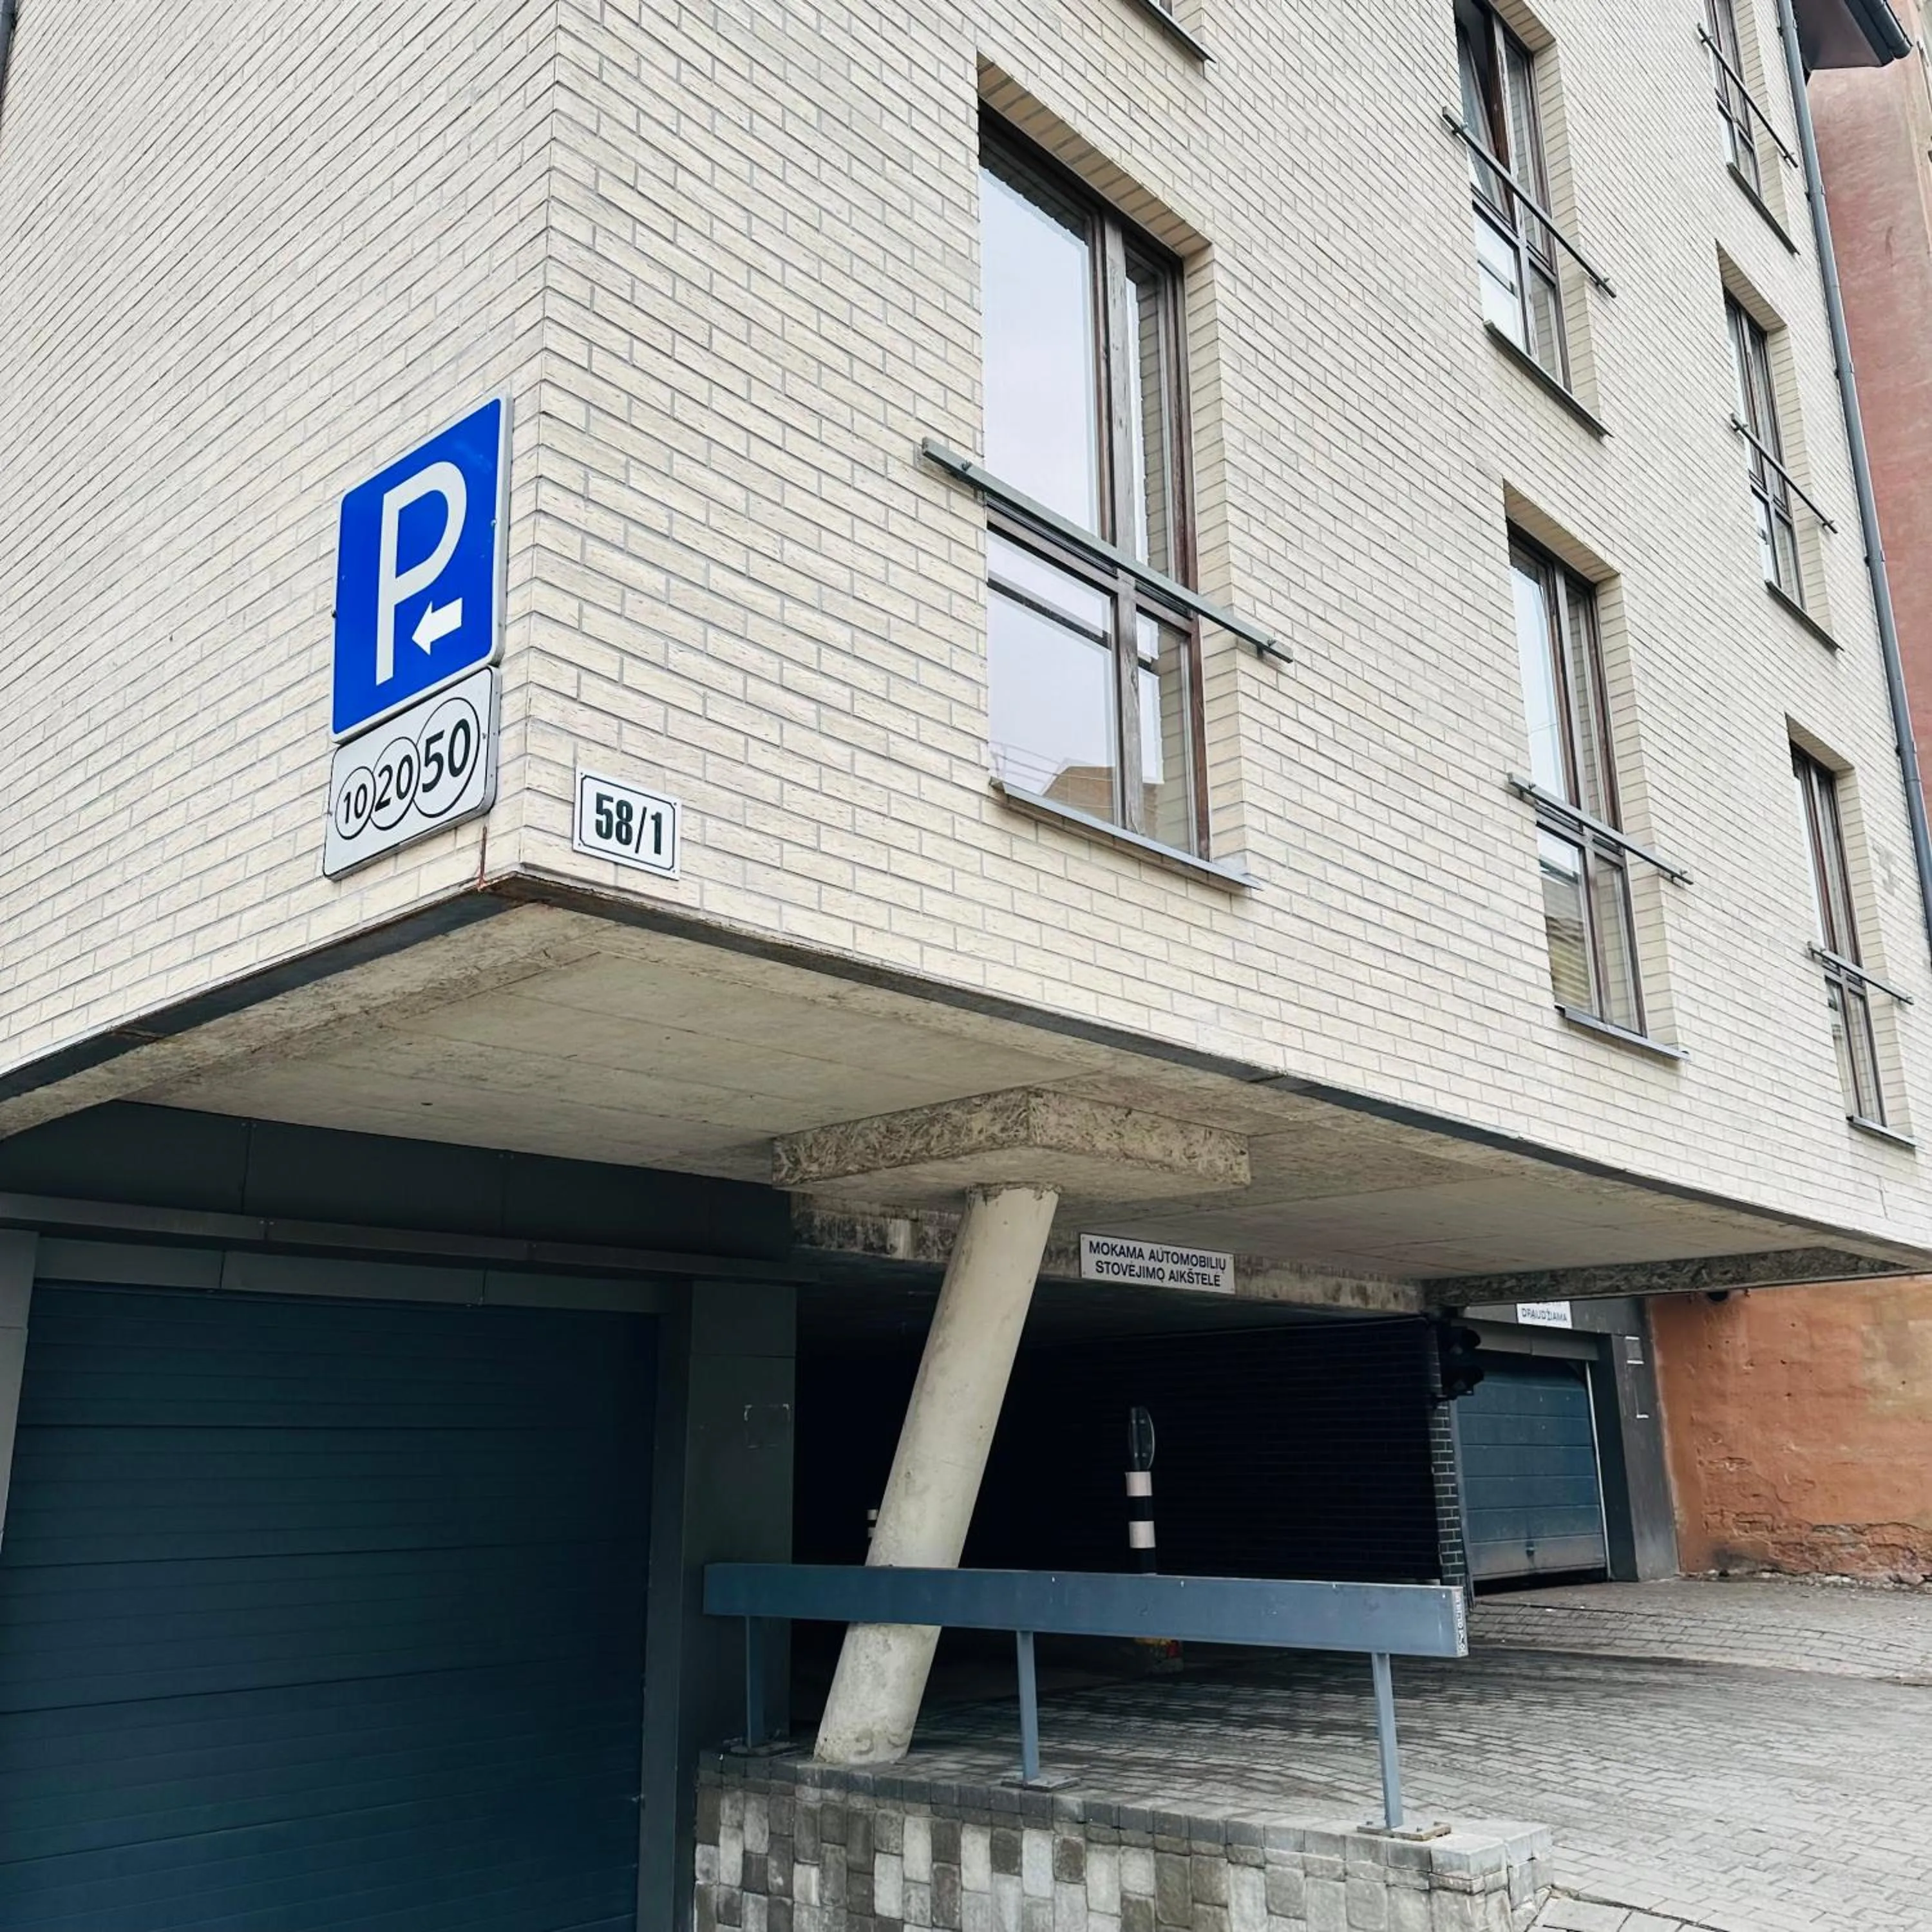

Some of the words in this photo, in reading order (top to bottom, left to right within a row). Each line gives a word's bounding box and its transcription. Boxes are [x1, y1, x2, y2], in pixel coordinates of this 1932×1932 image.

[377, 461, 466, 686] P
[343, 784, 368, 824] 10
[375, 754, 413, 811] 20
[422, 718, 471, 793] 50
[595, 793, 663, 856] 58/1
[1089, 1241, 1144, 1260] MOKAMA
